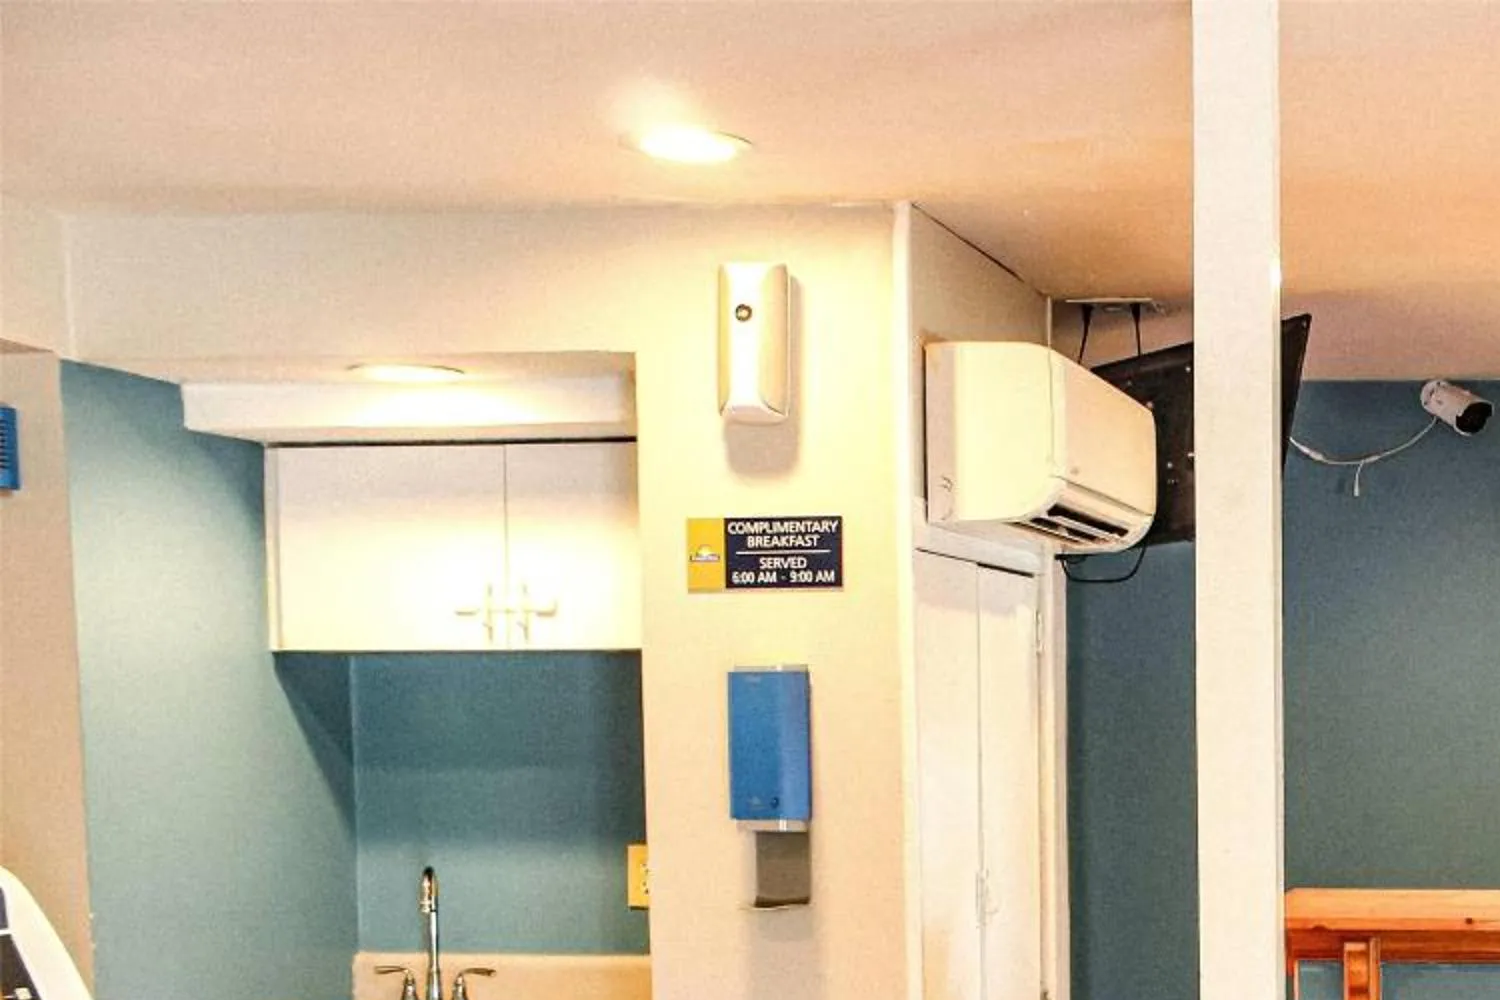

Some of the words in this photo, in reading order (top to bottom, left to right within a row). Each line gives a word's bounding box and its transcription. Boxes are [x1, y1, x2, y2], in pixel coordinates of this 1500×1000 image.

[727, 520, 839, 535] COMPLIMENTARY
[746, 534, 821, 549] BREAKFAST
[759, 556, 808, 570] SERVED
[731, 571, 756, 584] 6:00
[757, 570, 778, 584] AM
[789, 570, 813, 583] 9:00
[815, 569, 836, 583] AM
